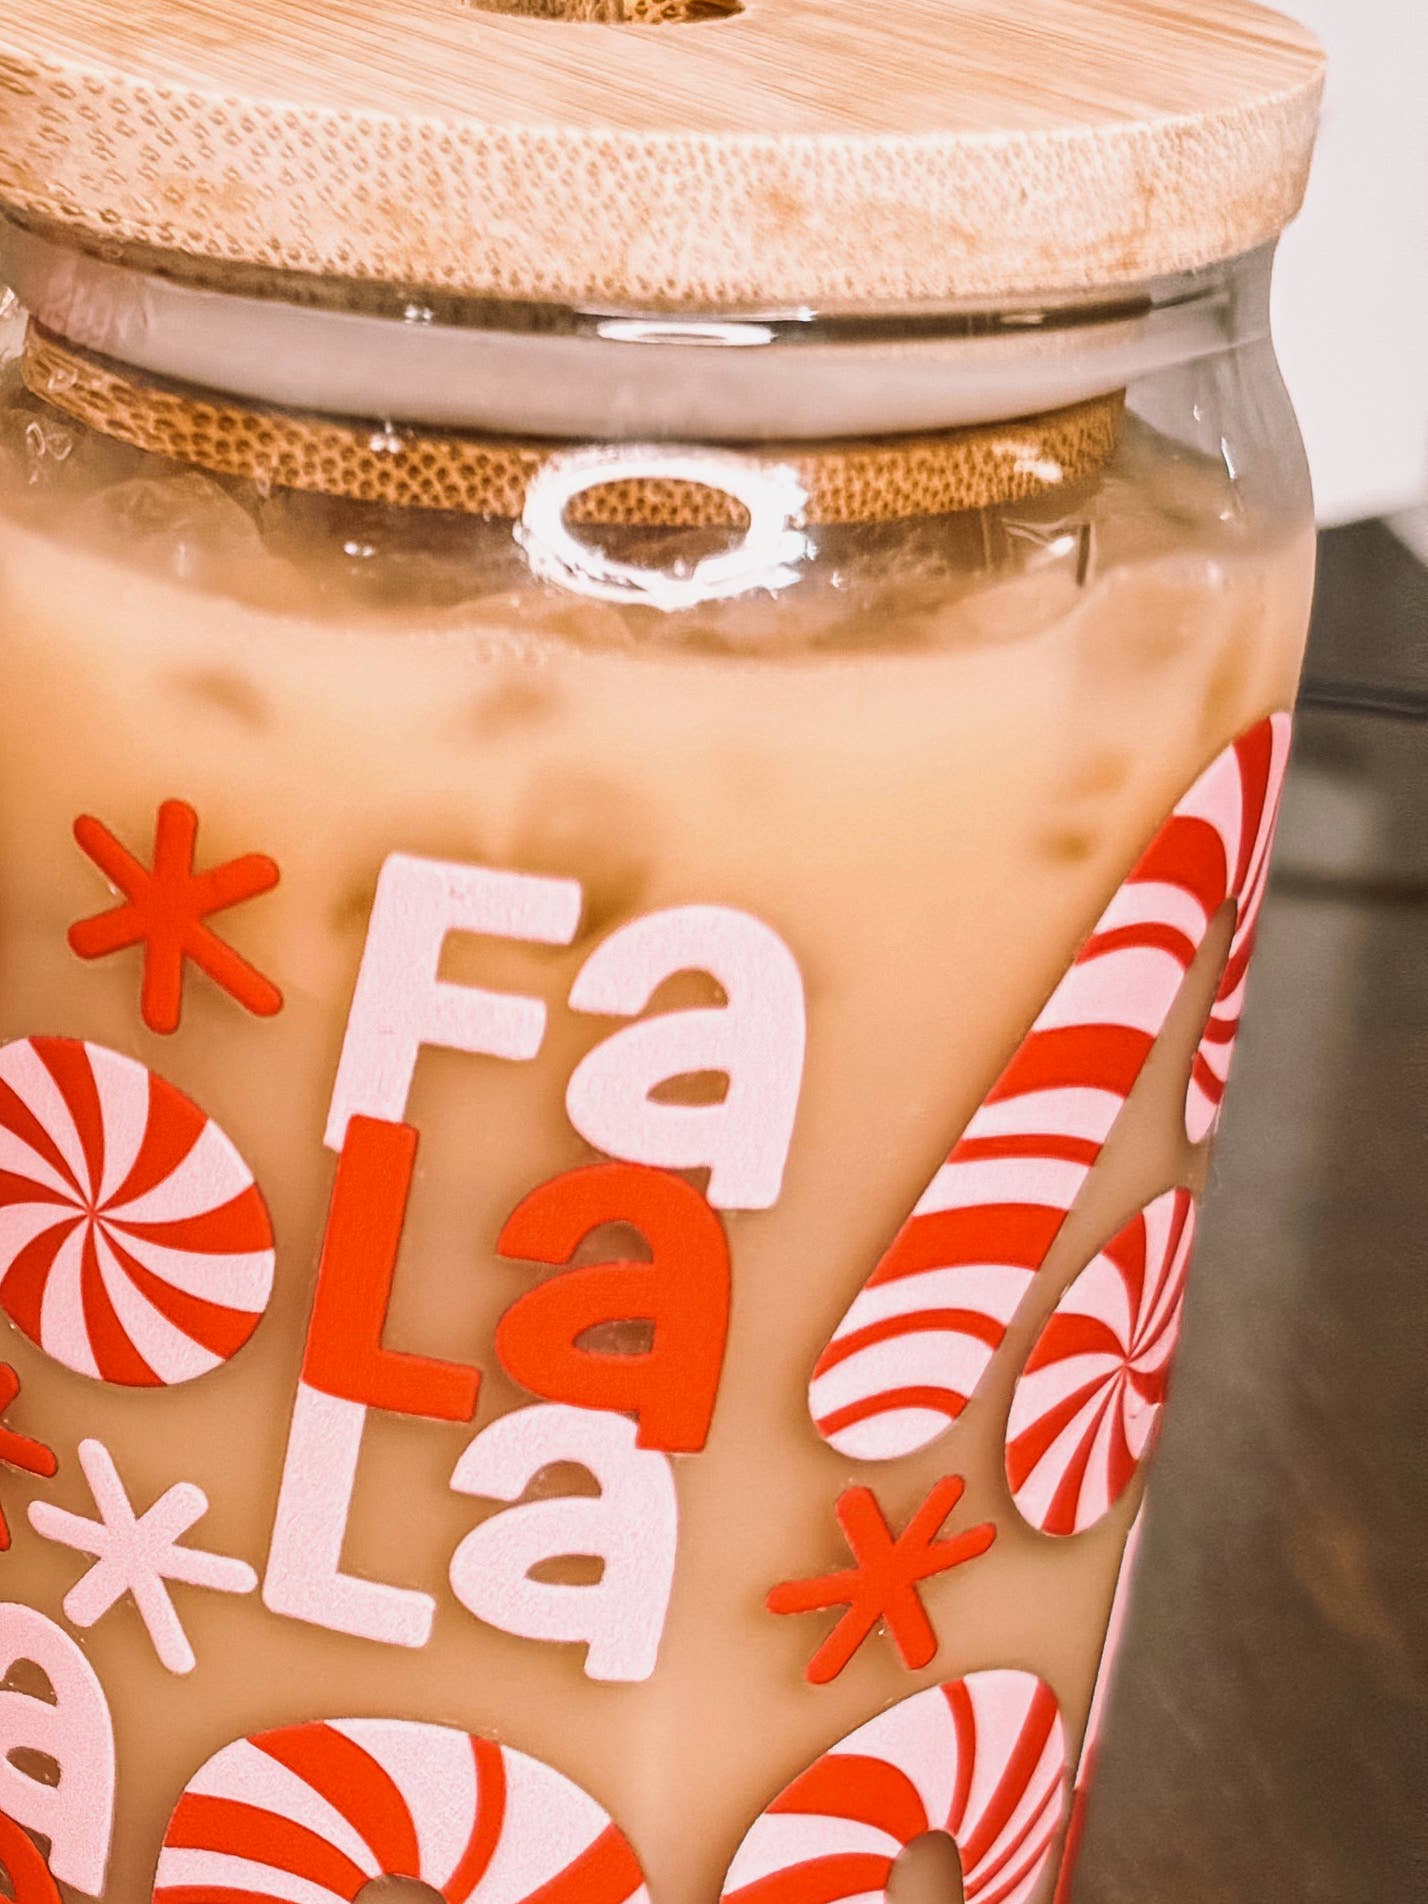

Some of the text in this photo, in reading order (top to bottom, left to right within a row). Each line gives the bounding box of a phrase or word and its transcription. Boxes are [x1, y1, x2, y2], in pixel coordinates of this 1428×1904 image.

[322, 852, 808, 1211] Fa
[301, 1114, 732, 1456] La
[262, 1388, 678, 1684] La
